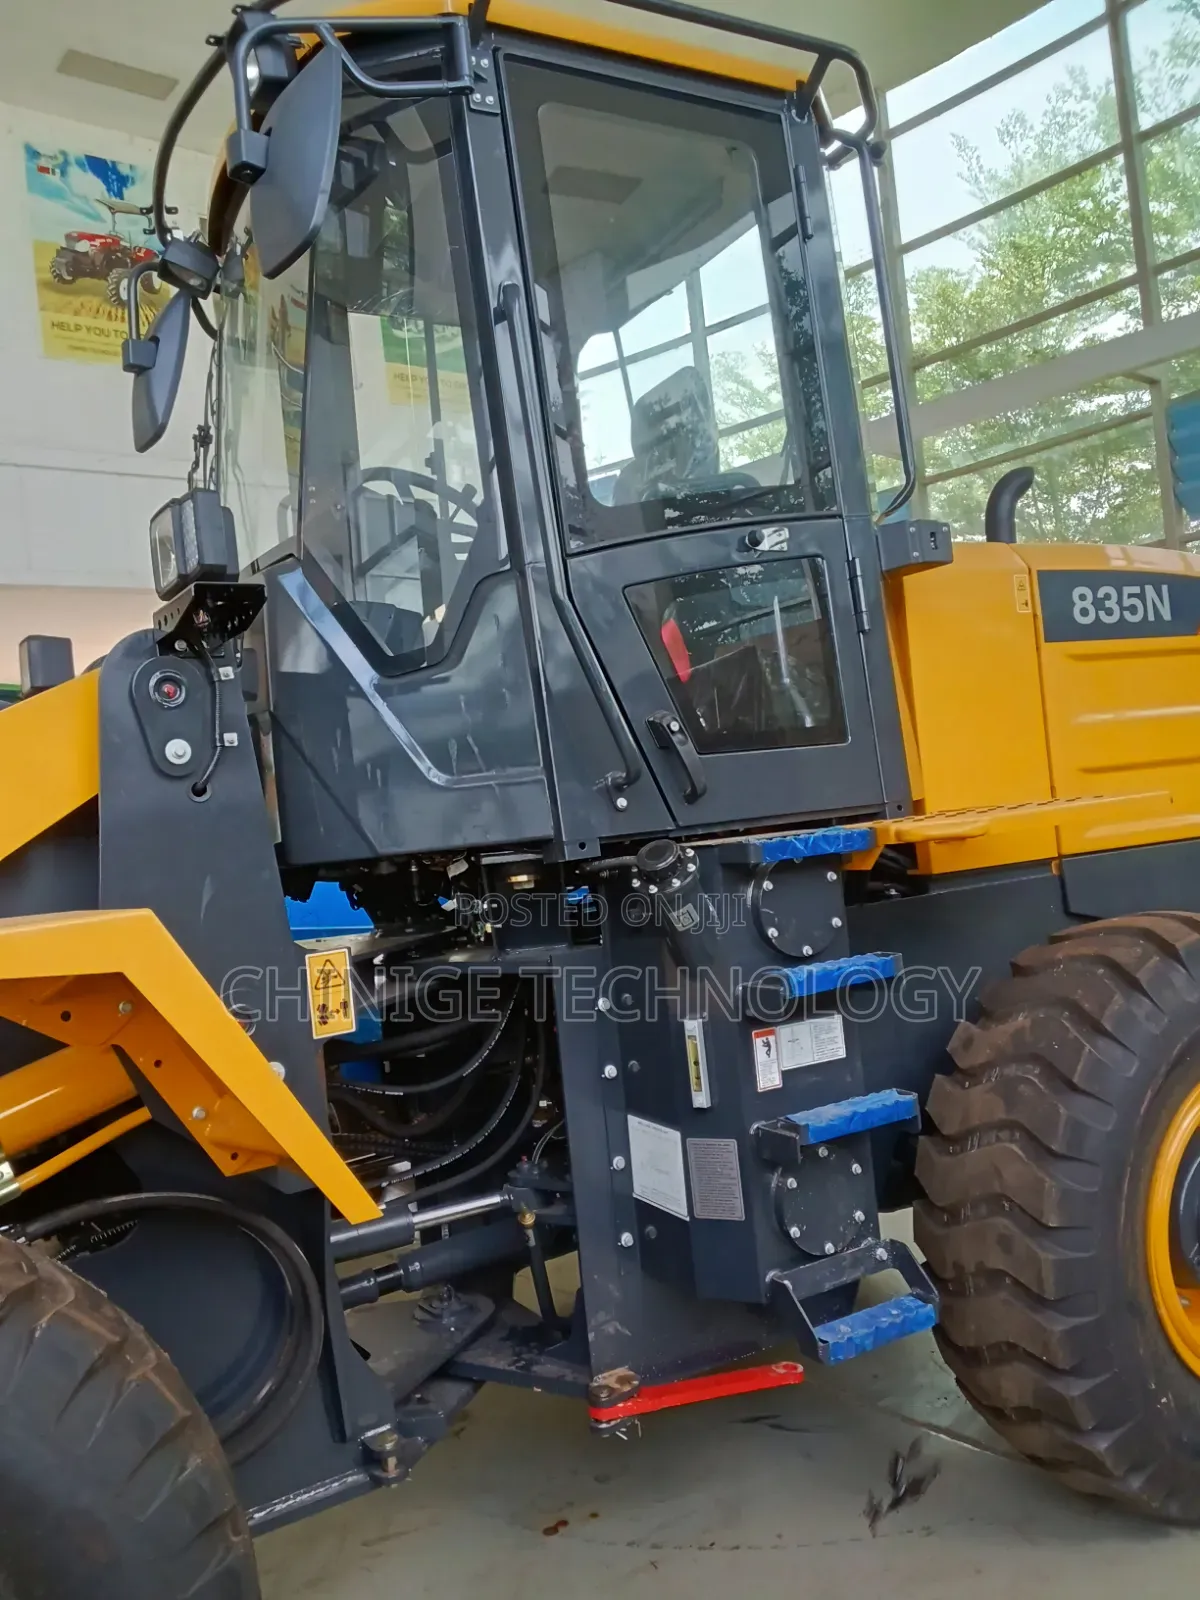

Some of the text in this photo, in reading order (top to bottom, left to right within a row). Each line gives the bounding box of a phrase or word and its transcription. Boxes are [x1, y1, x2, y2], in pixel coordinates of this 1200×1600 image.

[51, 320, 129, 341] HELP YOU TO
[1071, 584, 1173, 625] 835N
